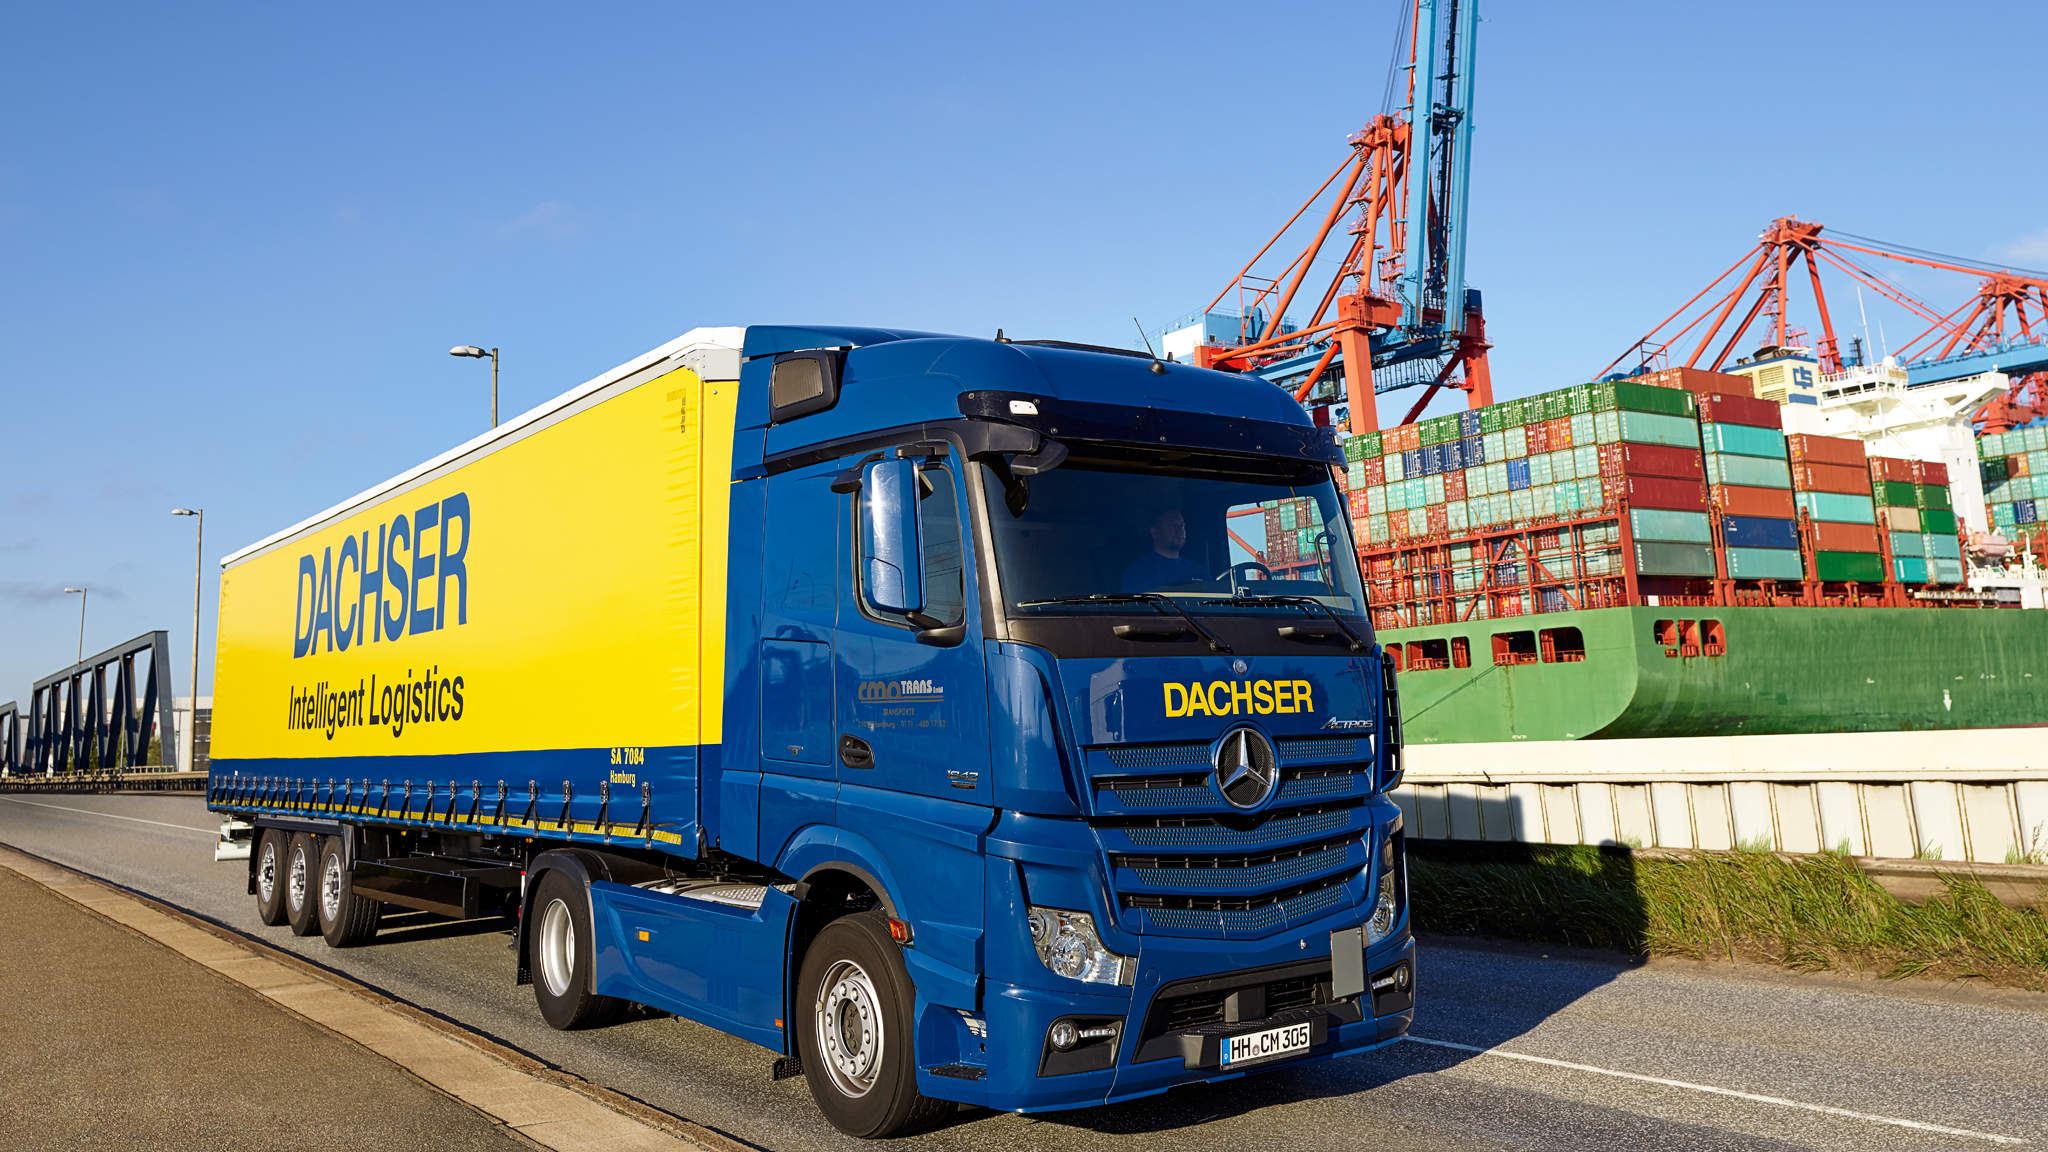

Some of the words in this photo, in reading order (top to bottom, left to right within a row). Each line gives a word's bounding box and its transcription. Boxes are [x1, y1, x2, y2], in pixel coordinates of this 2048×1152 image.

[293, 491, 471, 659] DACHSER
[288, 676, 365, 741] Intelligent
[370, 665, 464, 737] Logistics
[1164, 680, 1314, 717] DACHSER
[611, 748, 622, 765] SA
[624, 748, 644, 765] 7084
[610, 770, 636, 788] Hamburg
[1231, 1037, 1251, 1060] HH
[1260, 1032, 1280, 1053] CM
[1282, 1026, 1308, 1049] 305
